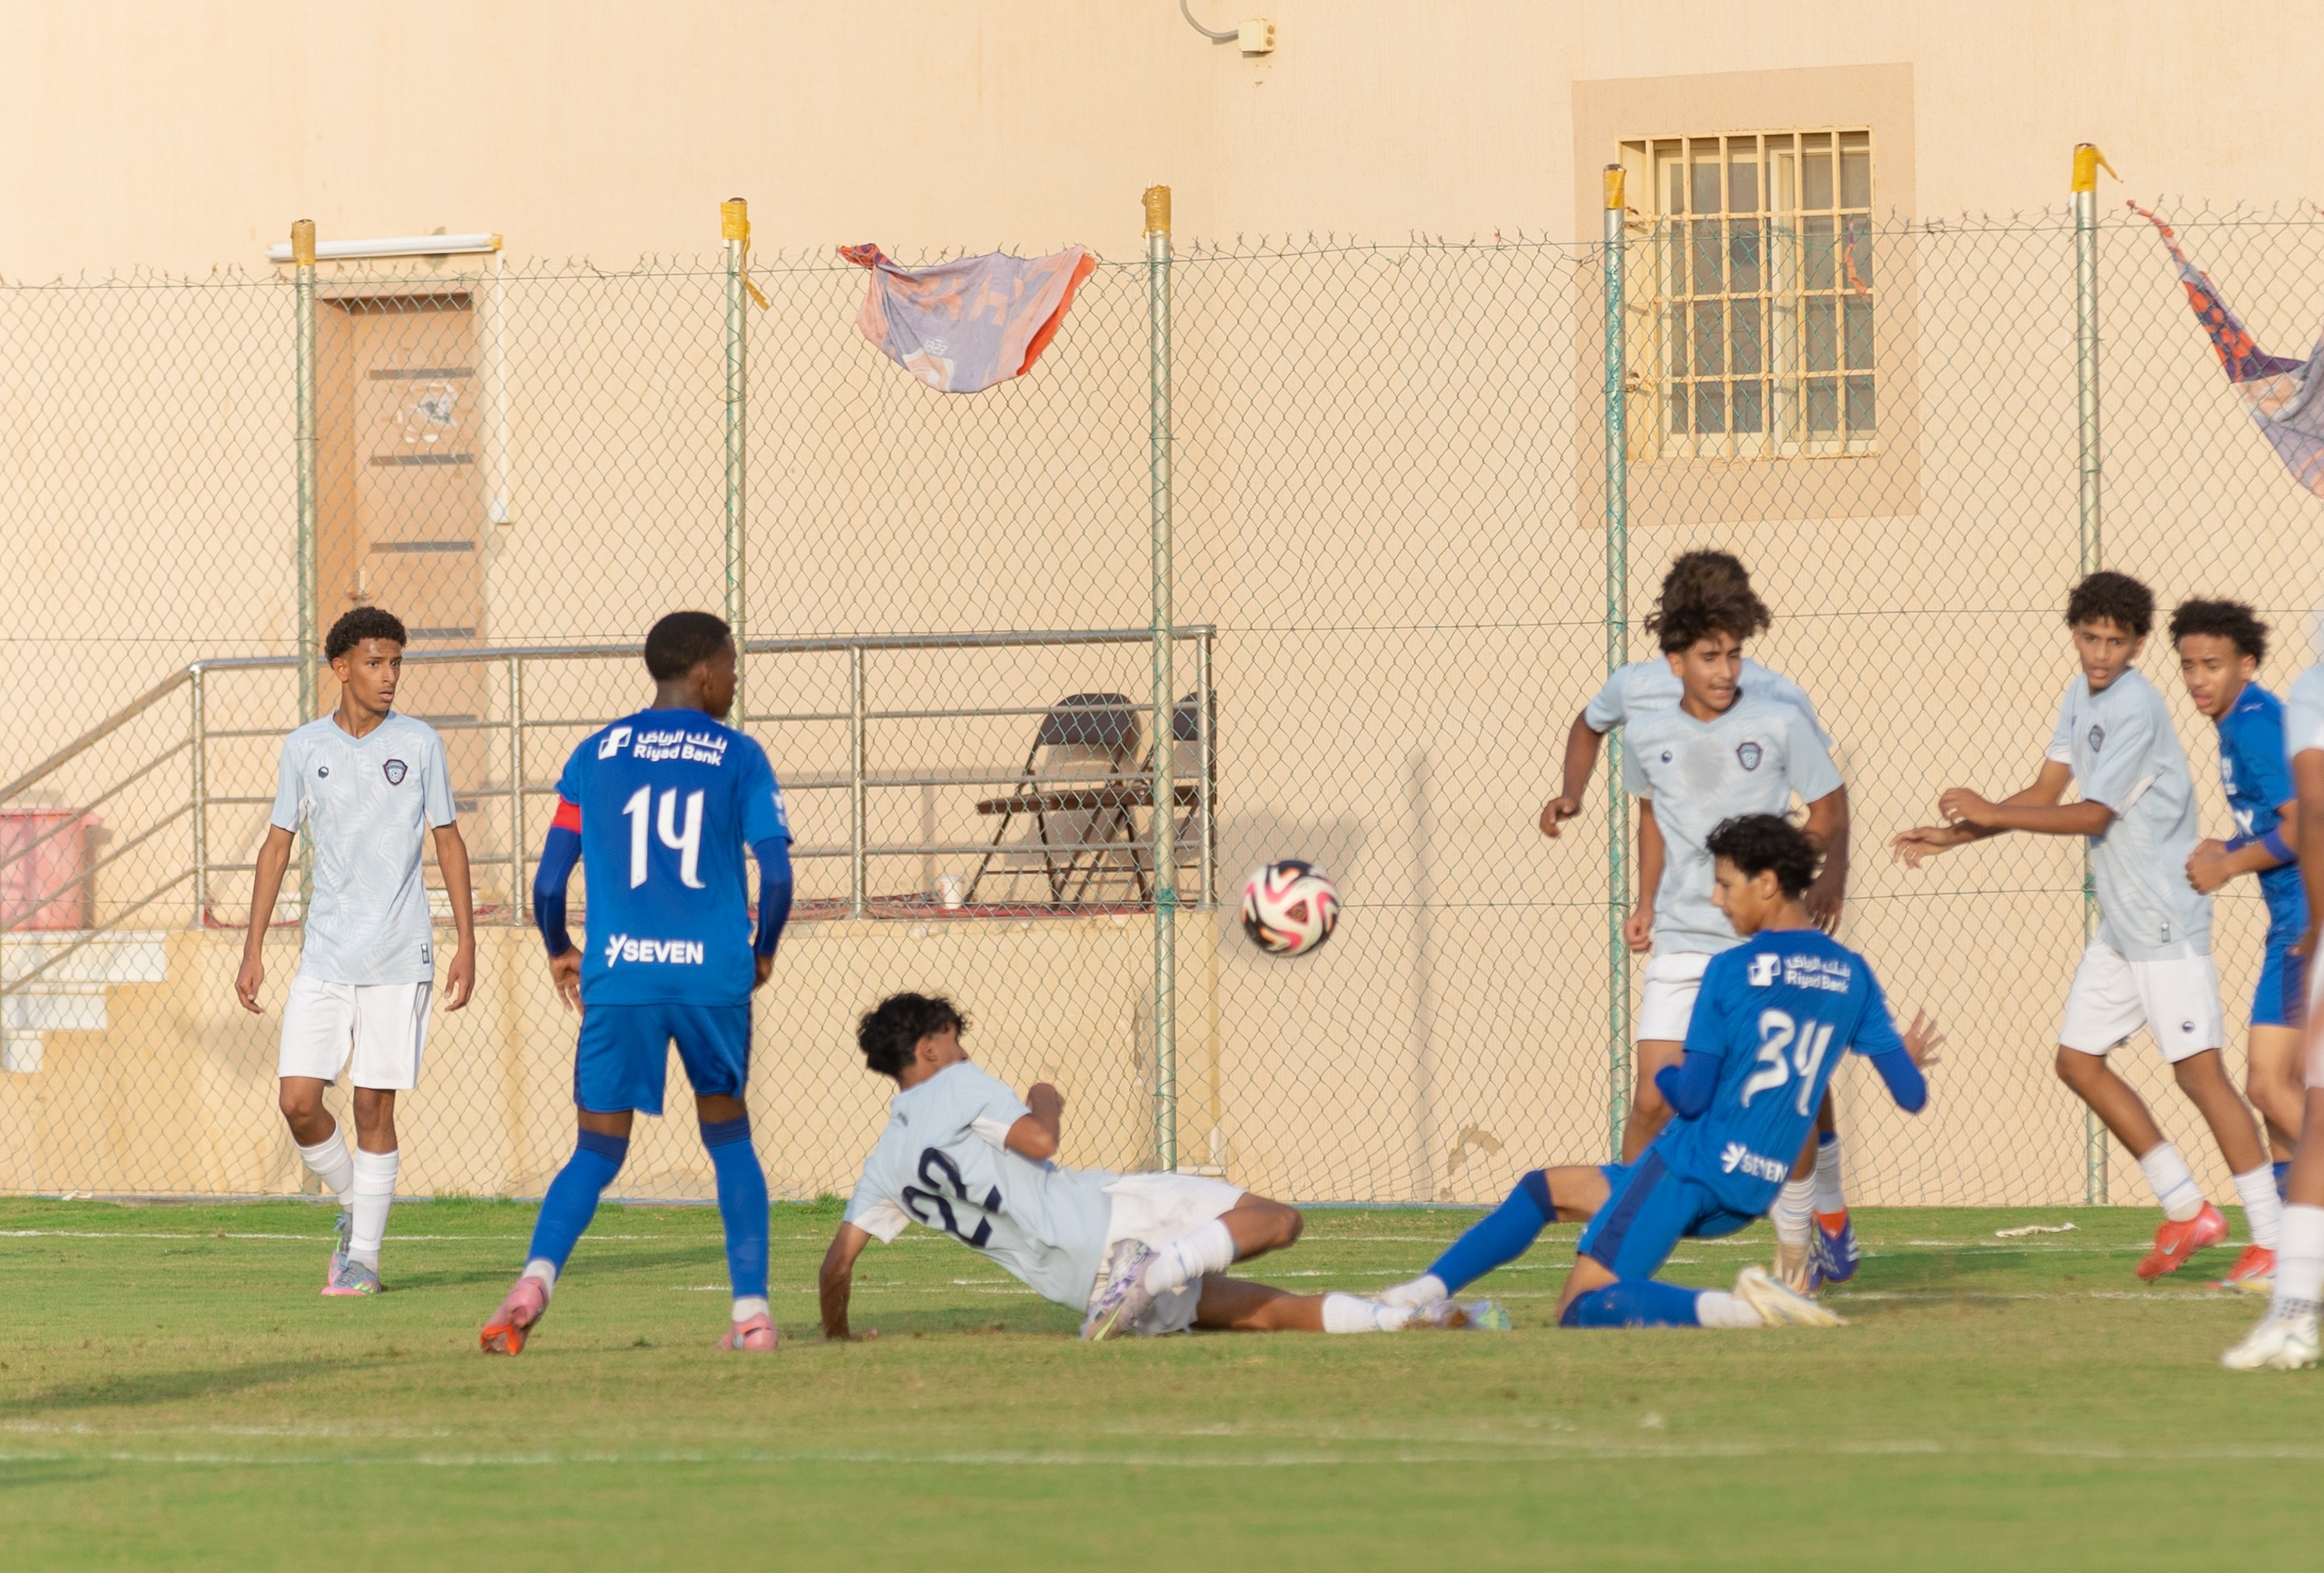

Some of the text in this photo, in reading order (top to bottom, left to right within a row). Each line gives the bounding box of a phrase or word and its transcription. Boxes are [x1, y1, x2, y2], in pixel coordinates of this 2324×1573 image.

[633, 744, 723, 766] Riyad Bank
[638, 728, 685, 746] الرياض
[623, 784, 706, 890] 14
[1785, 969, 1849, 993] Riyad Bank
[1741, 1010, 1835, 1117] 34
[901, 1147, 1002, 1248] 22
